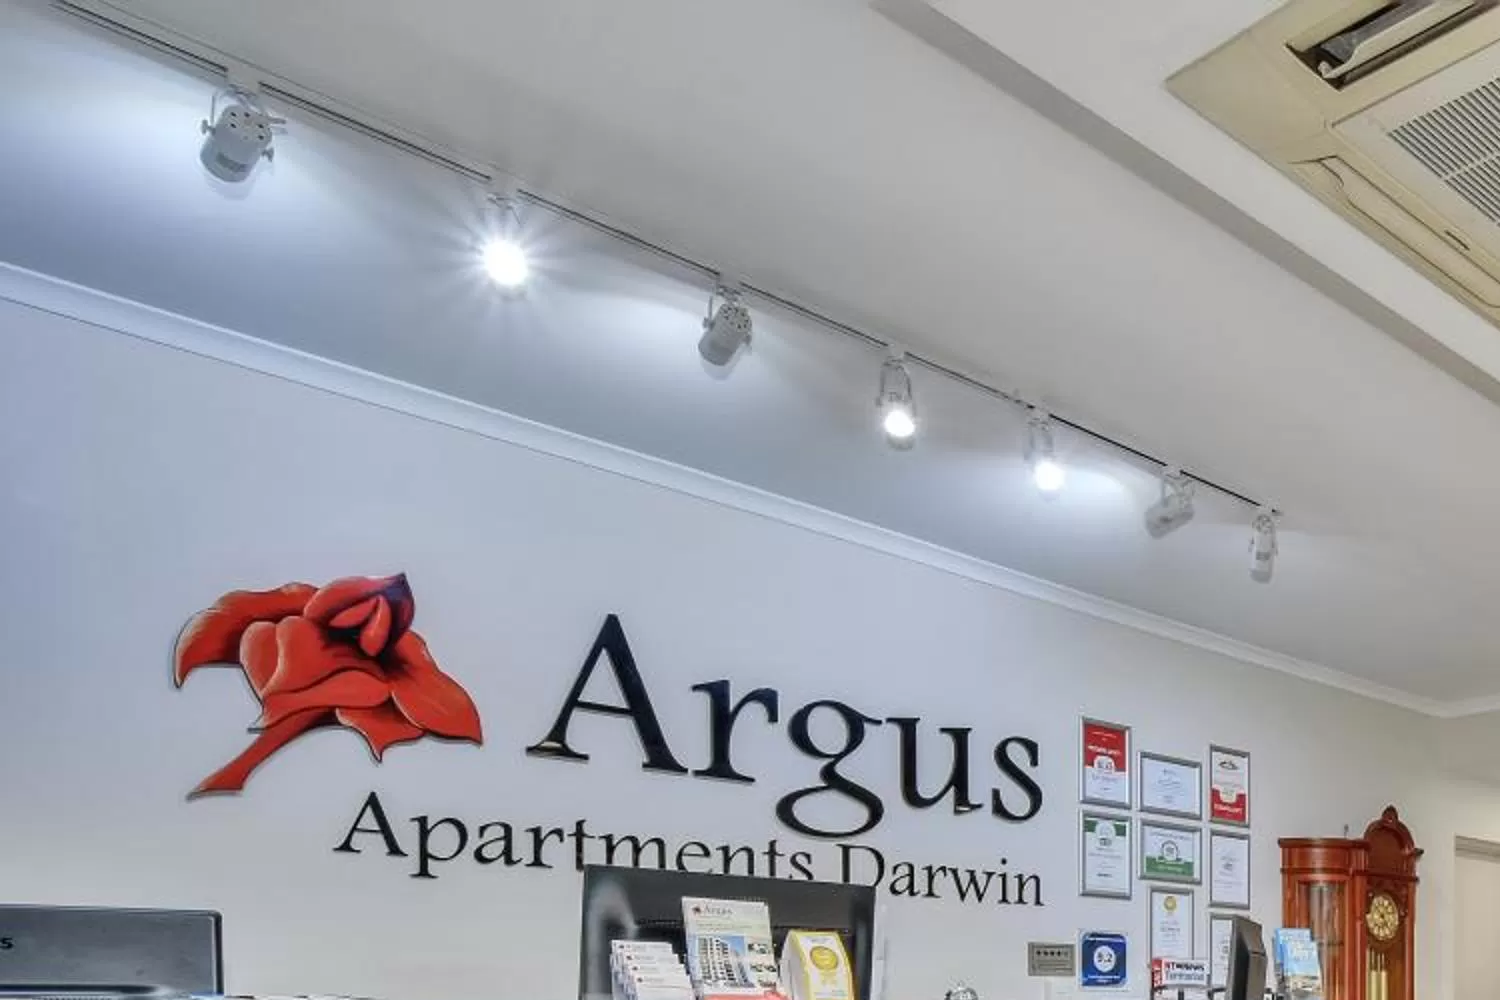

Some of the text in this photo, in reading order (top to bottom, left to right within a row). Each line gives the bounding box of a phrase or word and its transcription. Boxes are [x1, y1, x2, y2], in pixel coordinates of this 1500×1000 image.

[524, 612, 1043, 840] Argus
[332, 791, 1045, 907] Apartments Darwin
